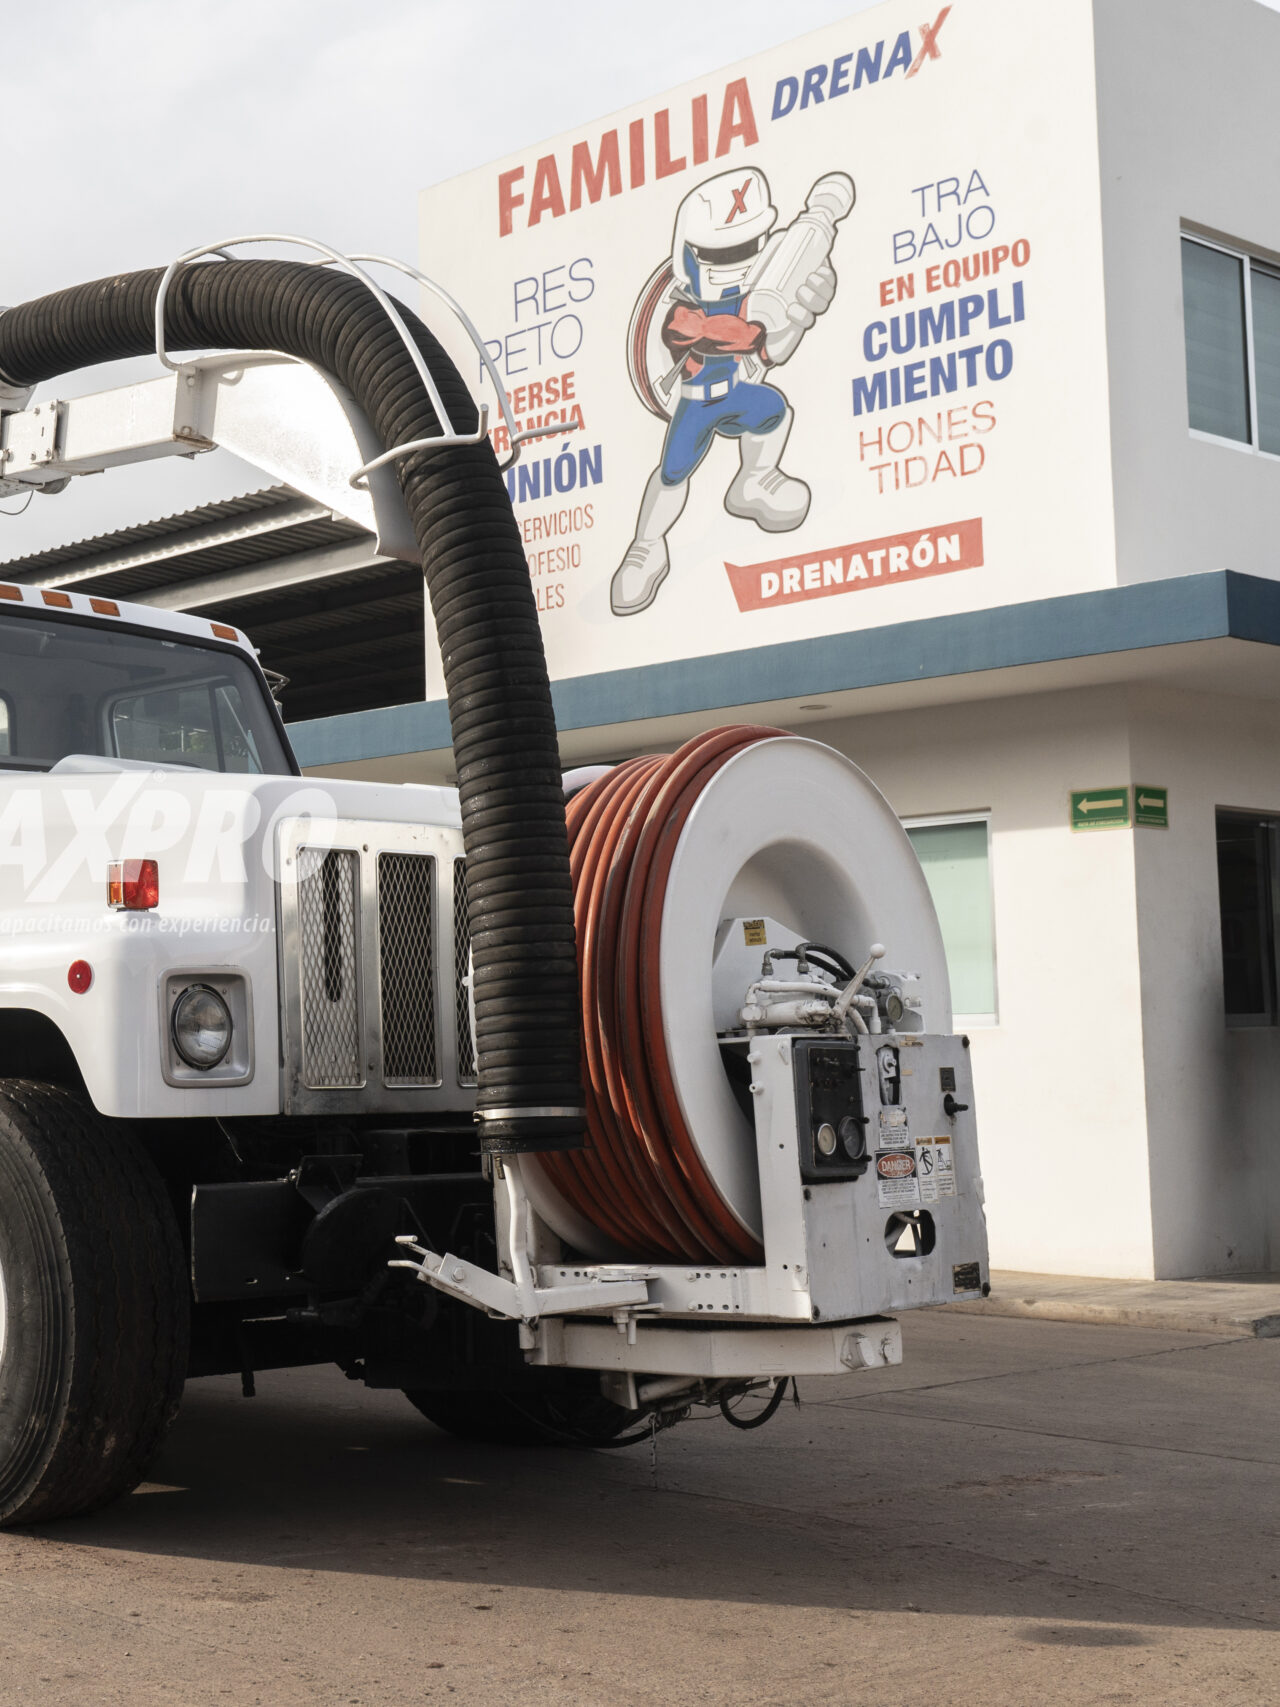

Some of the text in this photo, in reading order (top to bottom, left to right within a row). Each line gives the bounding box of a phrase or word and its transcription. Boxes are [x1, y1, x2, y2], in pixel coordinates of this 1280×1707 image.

[499, 4, 953, 238] FAMILIA DRENAX
[912, 169, 990, 218] TRA
[892, 205, 996, 265] BAJO
[513, 257, 595, 322] RES
[879, 238, 1030, 307] EN EQUIPO
[480, 313, 583, 384] PETO
[862, 280, 1026, 362] CUMPLI
[851, 339, 1014, 417] MIENTO
[858, 401, 997, 462] HONES
[869, 441, 986, 494] TIDAD
[517, 504, 595, 544] ERVICIOS
[527, 543, 582, 578] OFESIO
[759, 532, 961, 599] DRENATRÓN
[536, 583, 565, 612] LES
[881, 1160, 911, 1172] DANGER
